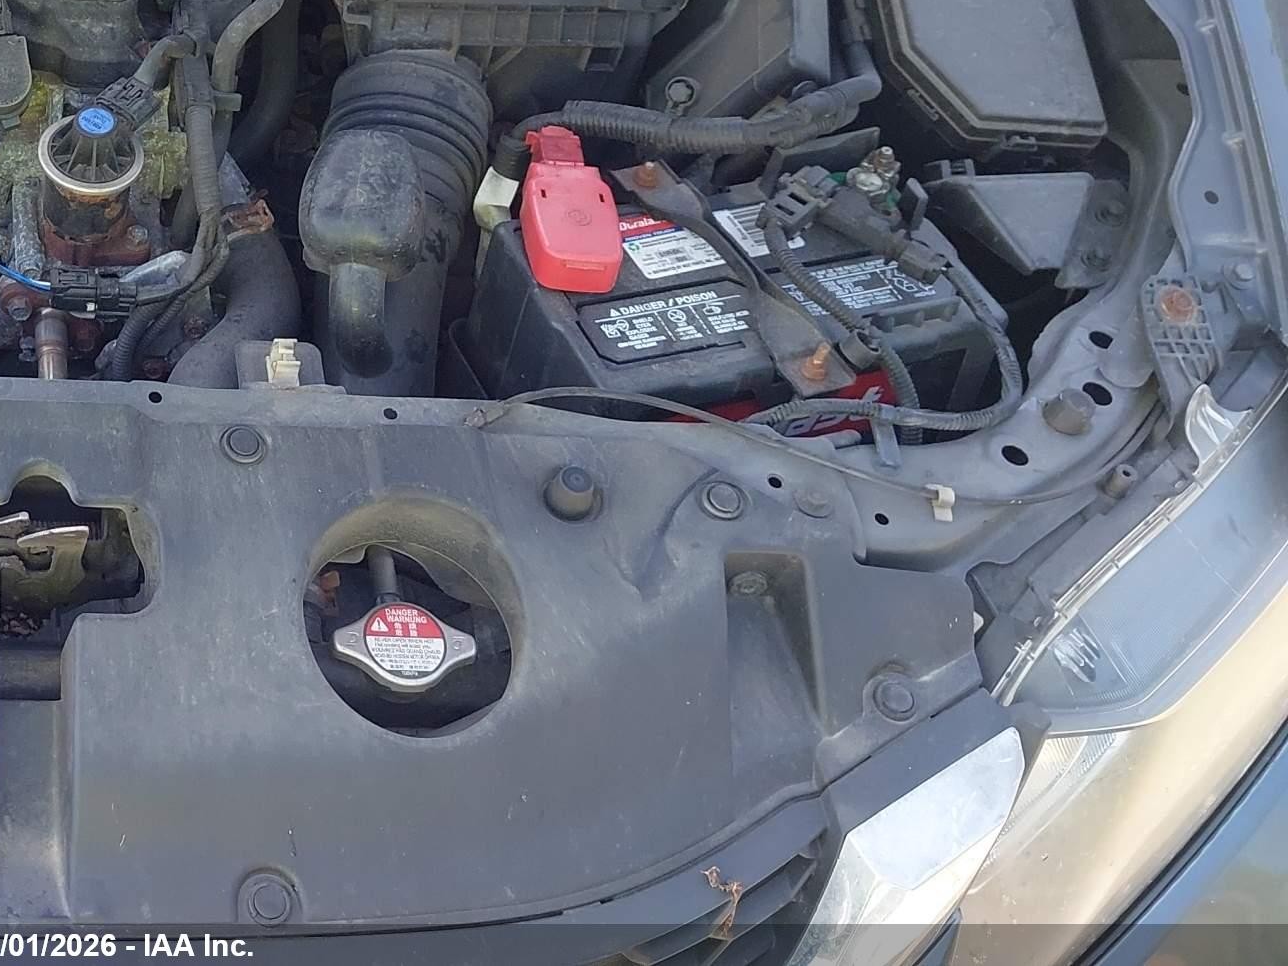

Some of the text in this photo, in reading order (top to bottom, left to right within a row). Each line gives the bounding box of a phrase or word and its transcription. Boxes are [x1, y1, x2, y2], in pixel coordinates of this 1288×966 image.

[619, 291, 718, 315] DANGER / POISON
[384, 608, 418, 616] DANGER
